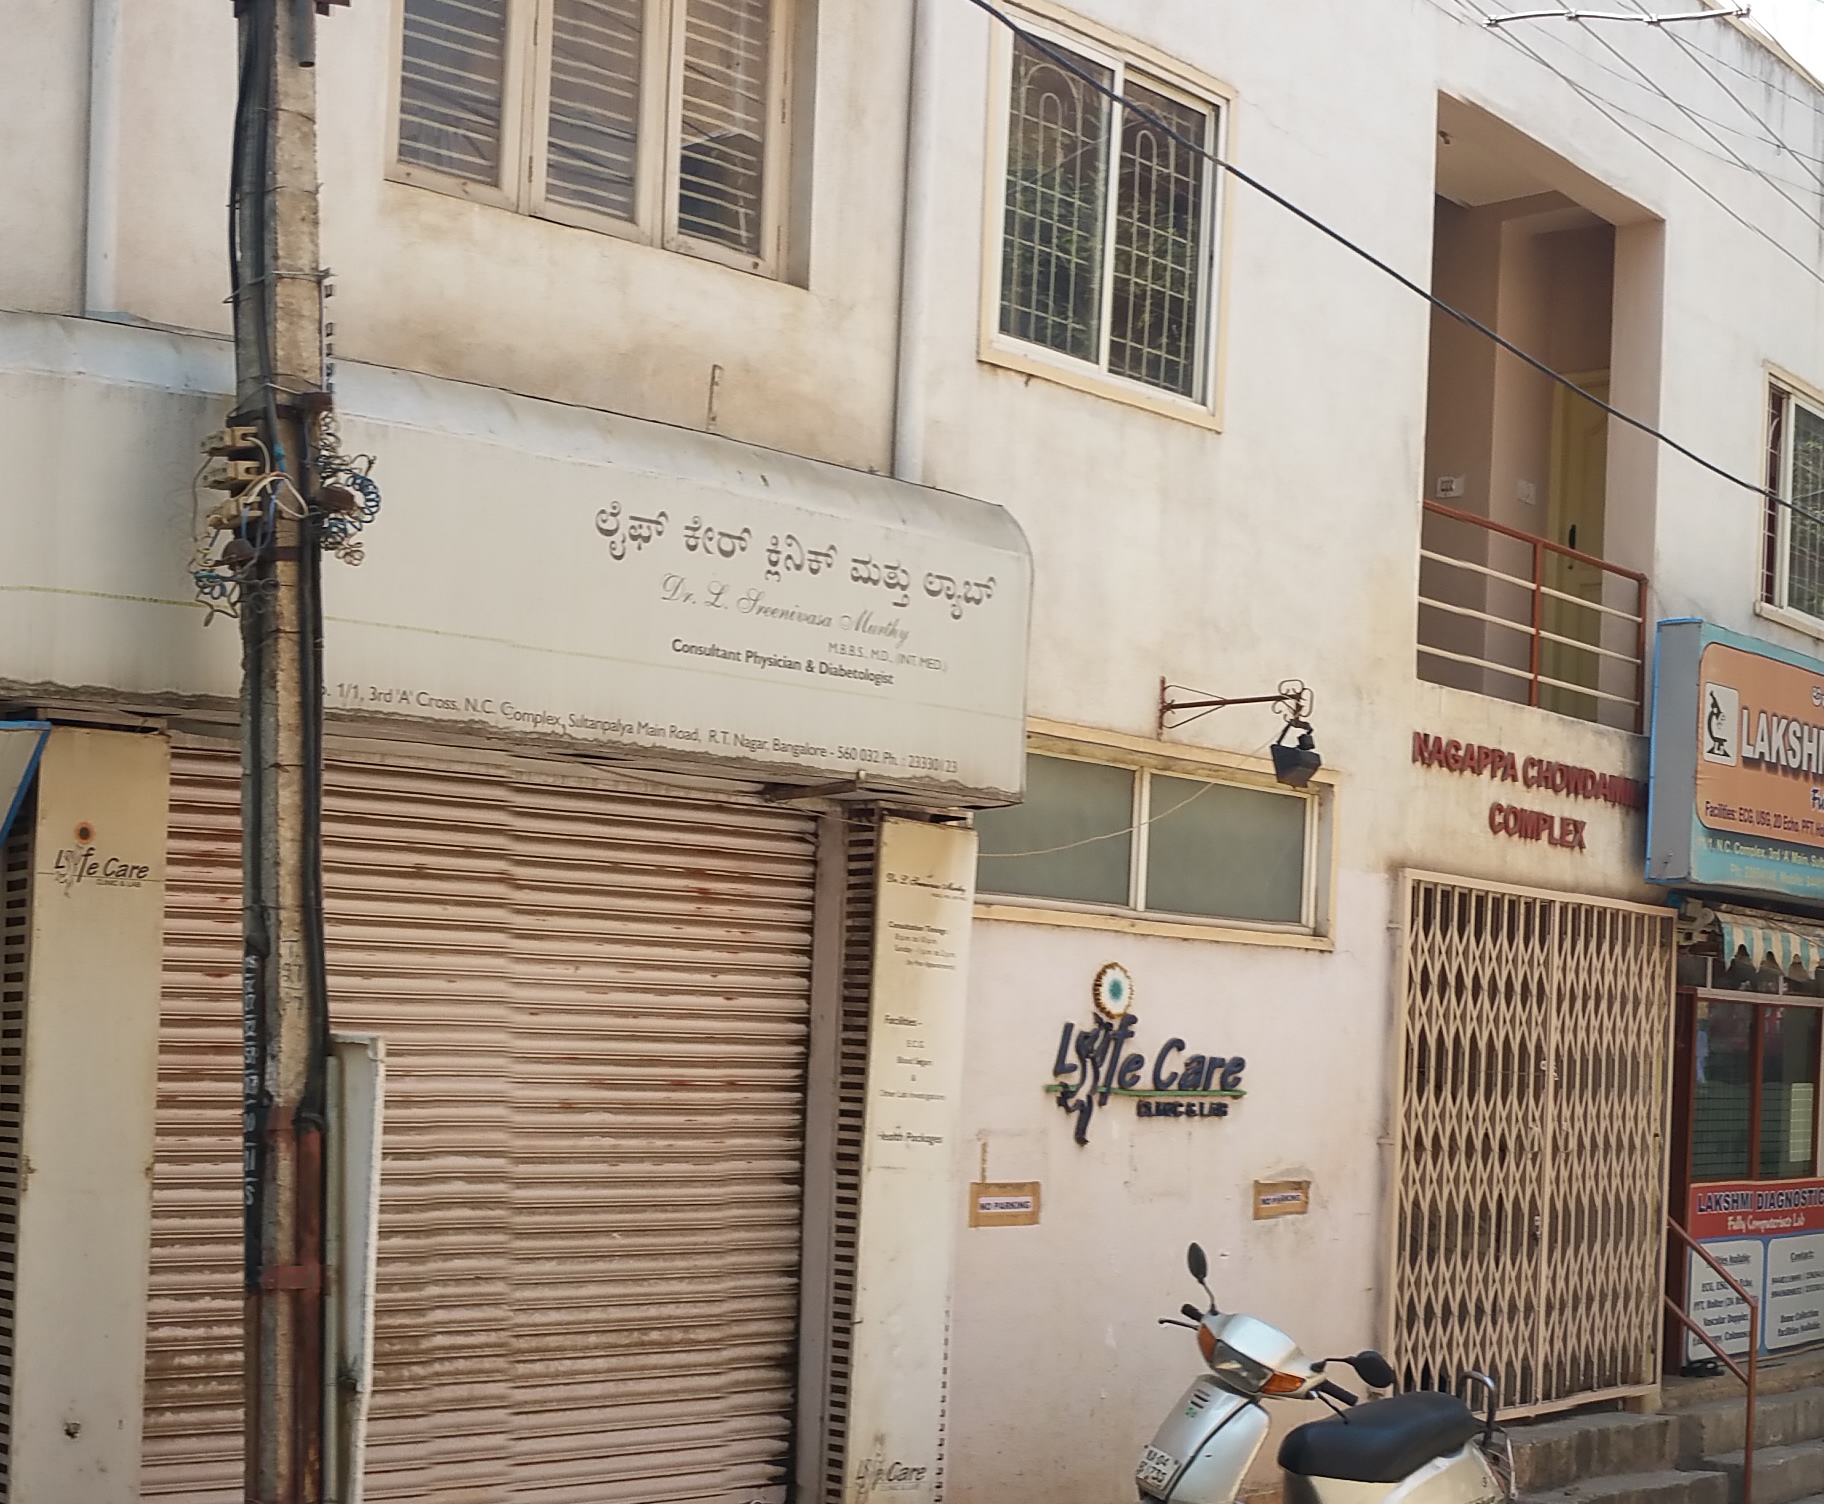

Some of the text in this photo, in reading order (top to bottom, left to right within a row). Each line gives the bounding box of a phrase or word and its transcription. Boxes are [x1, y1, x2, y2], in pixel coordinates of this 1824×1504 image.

[683, 515, 753, 558] ಕೇರ್
[850, 554, 911, 608] ಮತ್ತು
[659, 573, 696, 605] Dr.
[736, 588, 833, 629] Sreenivasa
[840, 608, 909, 649] Murthy
[671, 638, 894, 686] Consultant Physician & Diabetologist
[369, 687, 392, 703] 3rd
[568, 713, 634, 735] Sultanpalya
[637, 721, 665, 737] Main
[669, 724, 702, 743] Road,
[773, 737, 827, 757] Bangalore
[837, 746, 857, 760] 560
[859, 749, 879, 763] 032
[1412, 731, 1519, 783] NAGAPPA
[1488, 802, 1587, 851] COMPLEX
[103, 857, 150, 879] Care
[1153, 1037, 1246, 1091] Care
[1697, 1190, 1754, 1214] LAKSHMI
